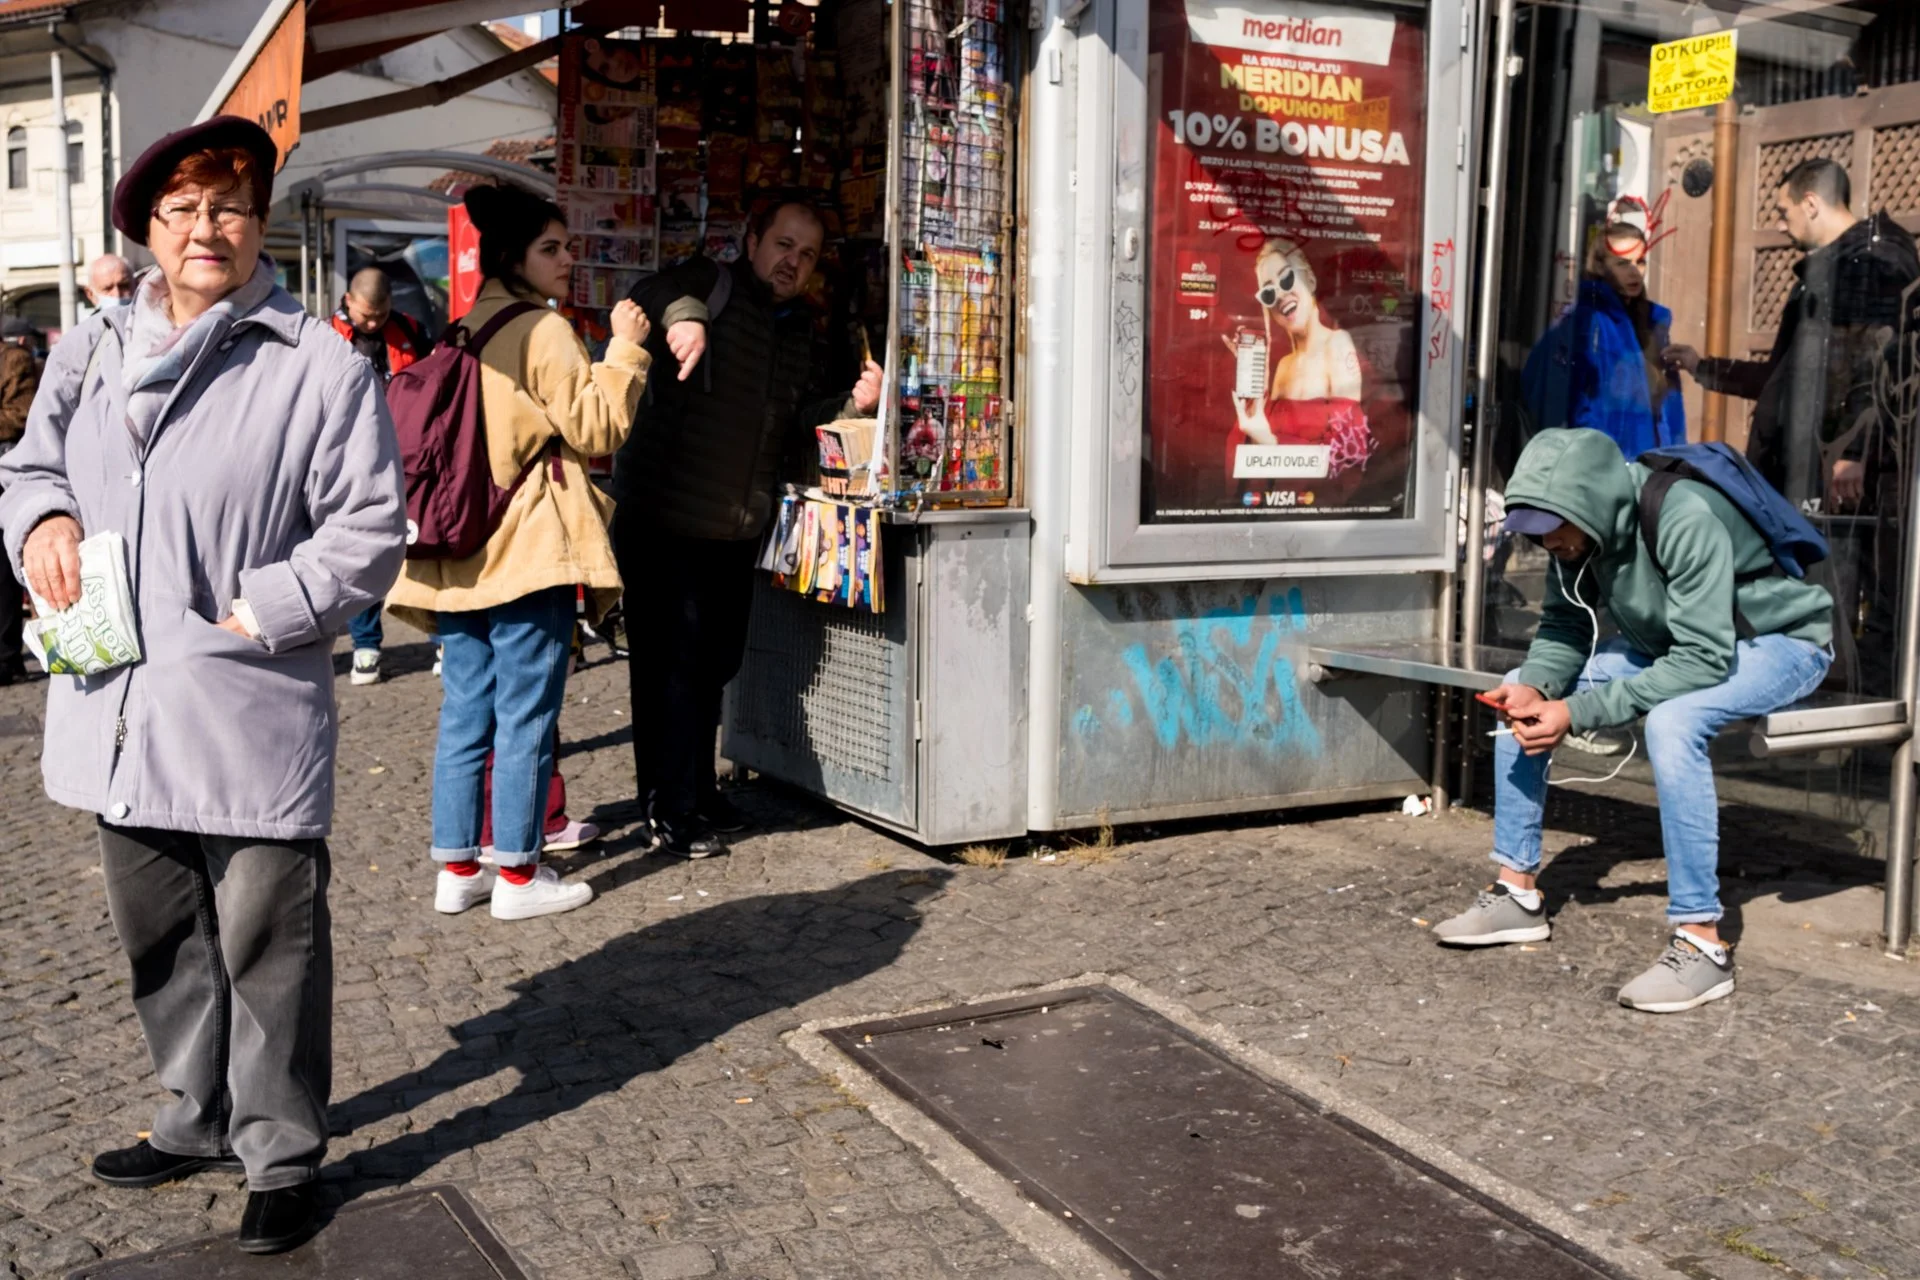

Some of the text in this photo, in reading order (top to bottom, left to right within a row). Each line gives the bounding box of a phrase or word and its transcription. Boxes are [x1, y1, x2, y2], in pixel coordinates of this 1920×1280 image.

[1243, 16, 1342, 47] meridian
[1656, 36, 1732, 61] OTKUP!!!
[1242, 54, 1259, 66] NA
[1298, 60, 1341, 75] UPLATU
[1220, 62, 1363, 103] MERIDIAN
[1653, 75, 1728, 96] LAPTOPA
[1168, 108, 1411, 166] 10% BONUSA
[1246, 455, 1282, 468] UPLATI
[1265, 491, 1296, 507] VISA
